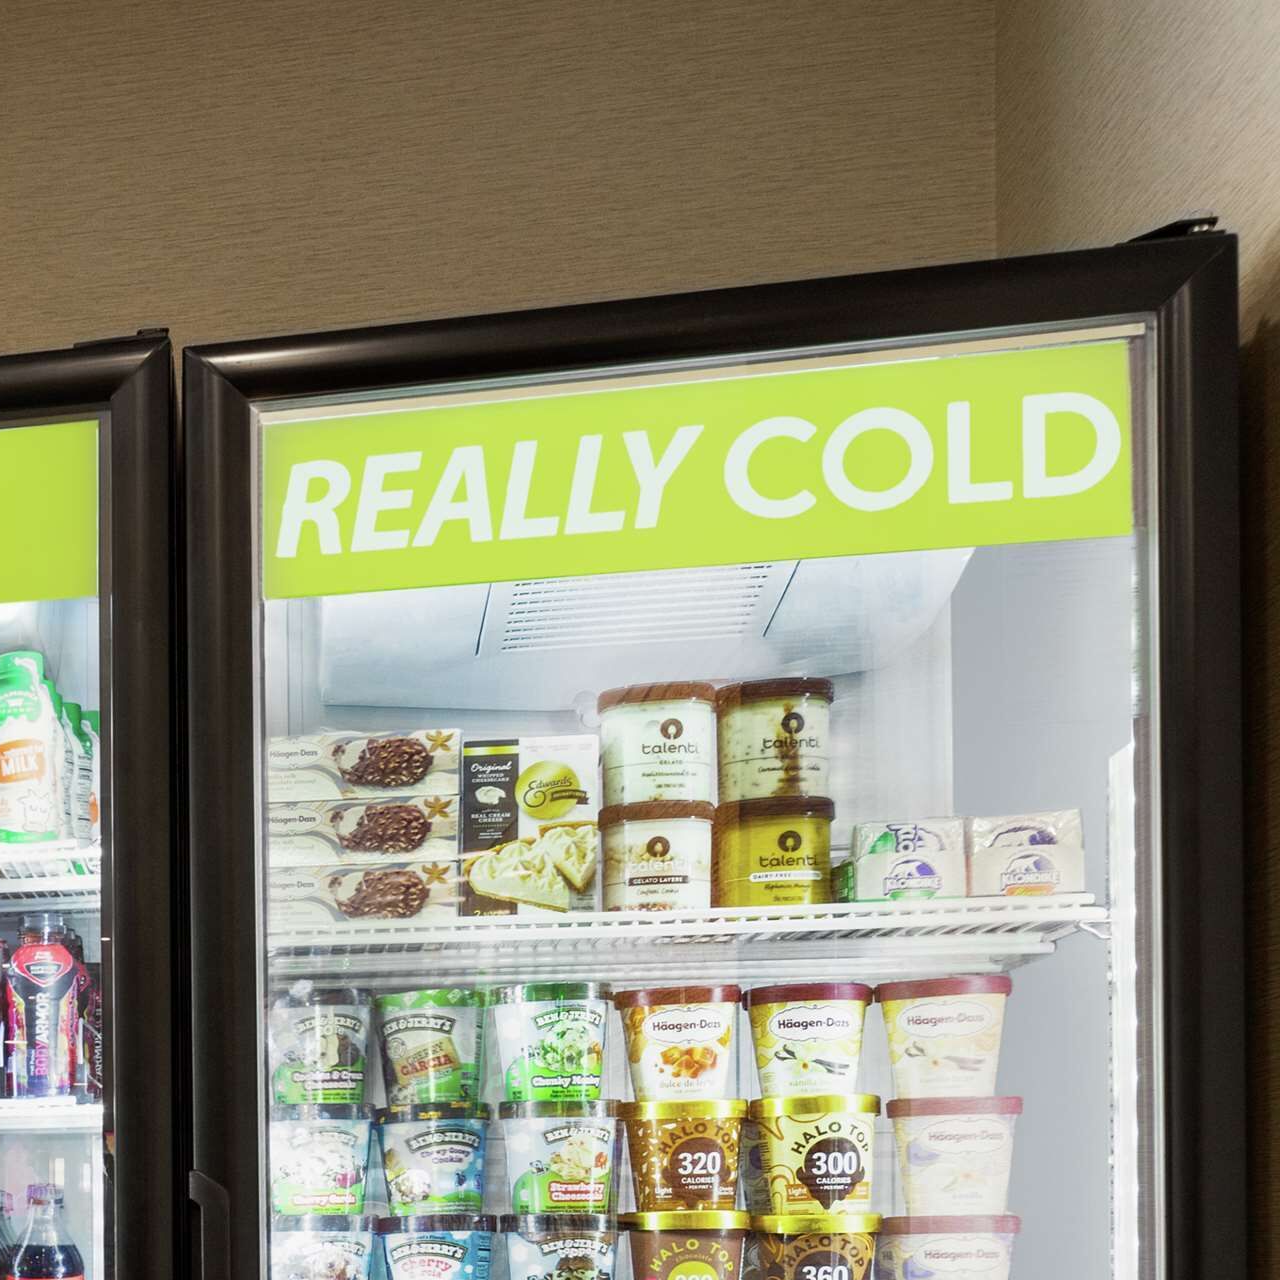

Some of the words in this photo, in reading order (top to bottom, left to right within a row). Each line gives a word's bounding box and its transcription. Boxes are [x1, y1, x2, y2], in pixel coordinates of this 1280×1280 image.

[274, 425, 706, 557] REALLY
[723, 391, 1122, 518] COLD
[642, 742, 699, 755] talenti
[762, 737, 820, 749] talenti
[0, 754, 40, 776] MILK
[471, 761, 513, 774] Original
[758, 856, 820, 868] talenti
[35, 991, 51, 1076] BODYARMOR
[652, 1018, 721, 1032] Häagen-Dazs
[777, 1017, 850, 1031] Häagen-Dazs
[400, 1054, 454, 1076] GARCIA
[657, 1122, 709, 1155] HALO
[714, 1124, 737, 1153] TOP
[791, 1121, 842, 1154] HALO
[849, 1124, 870, 1152] TOP
[678, 1151, 721, 1175] 320
[811, 1151, 858, 1175] 300
[649, 1238, 700, 1272] HALO
[710, 1241, 735, 1273] TOP
[786, 1235, 831, 1267] HALO
[840, 1239, 865, 1267] TOP
